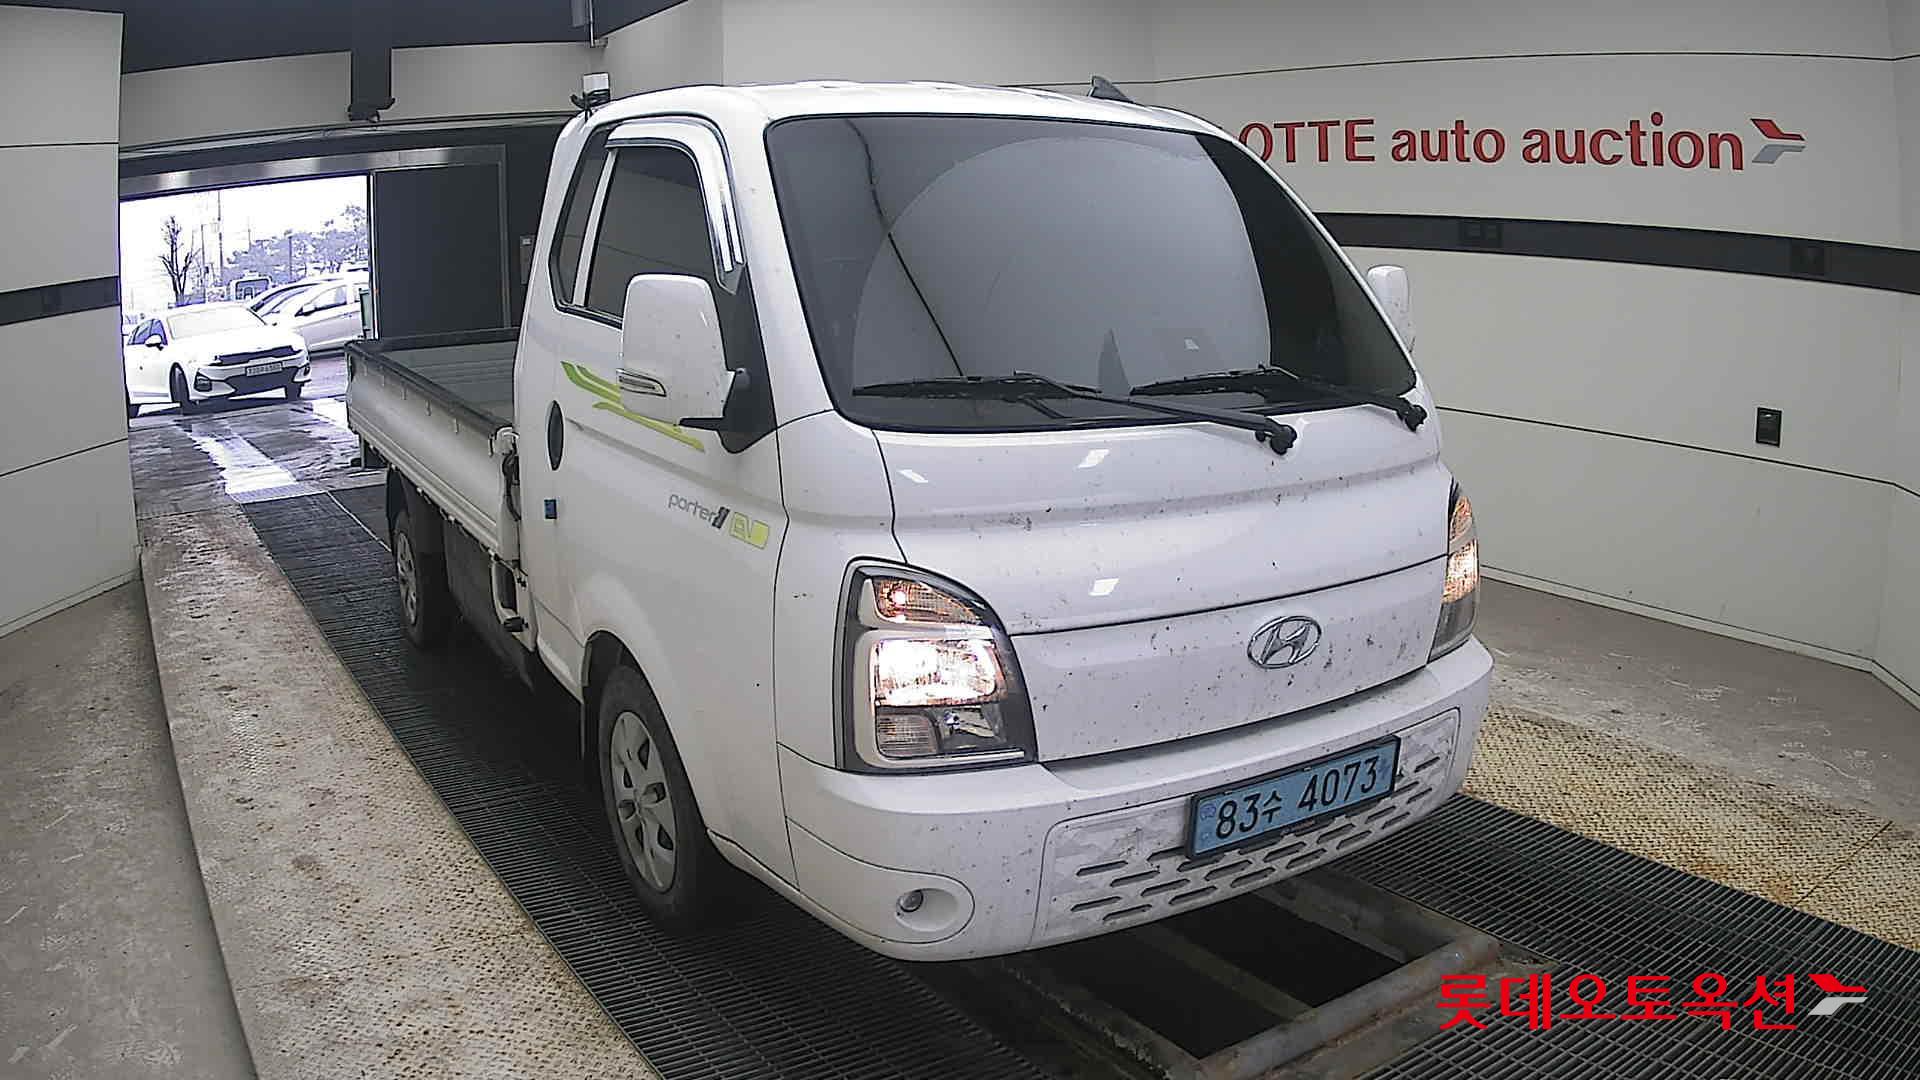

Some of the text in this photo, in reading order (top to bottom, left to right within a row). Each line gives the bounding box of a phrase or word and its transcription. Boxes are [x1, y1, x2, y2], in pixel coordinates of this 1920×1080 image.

[1237, 111, 1745, 172] OTTE auto auction
[1215, 754, 1381, 840] 83수 4073
